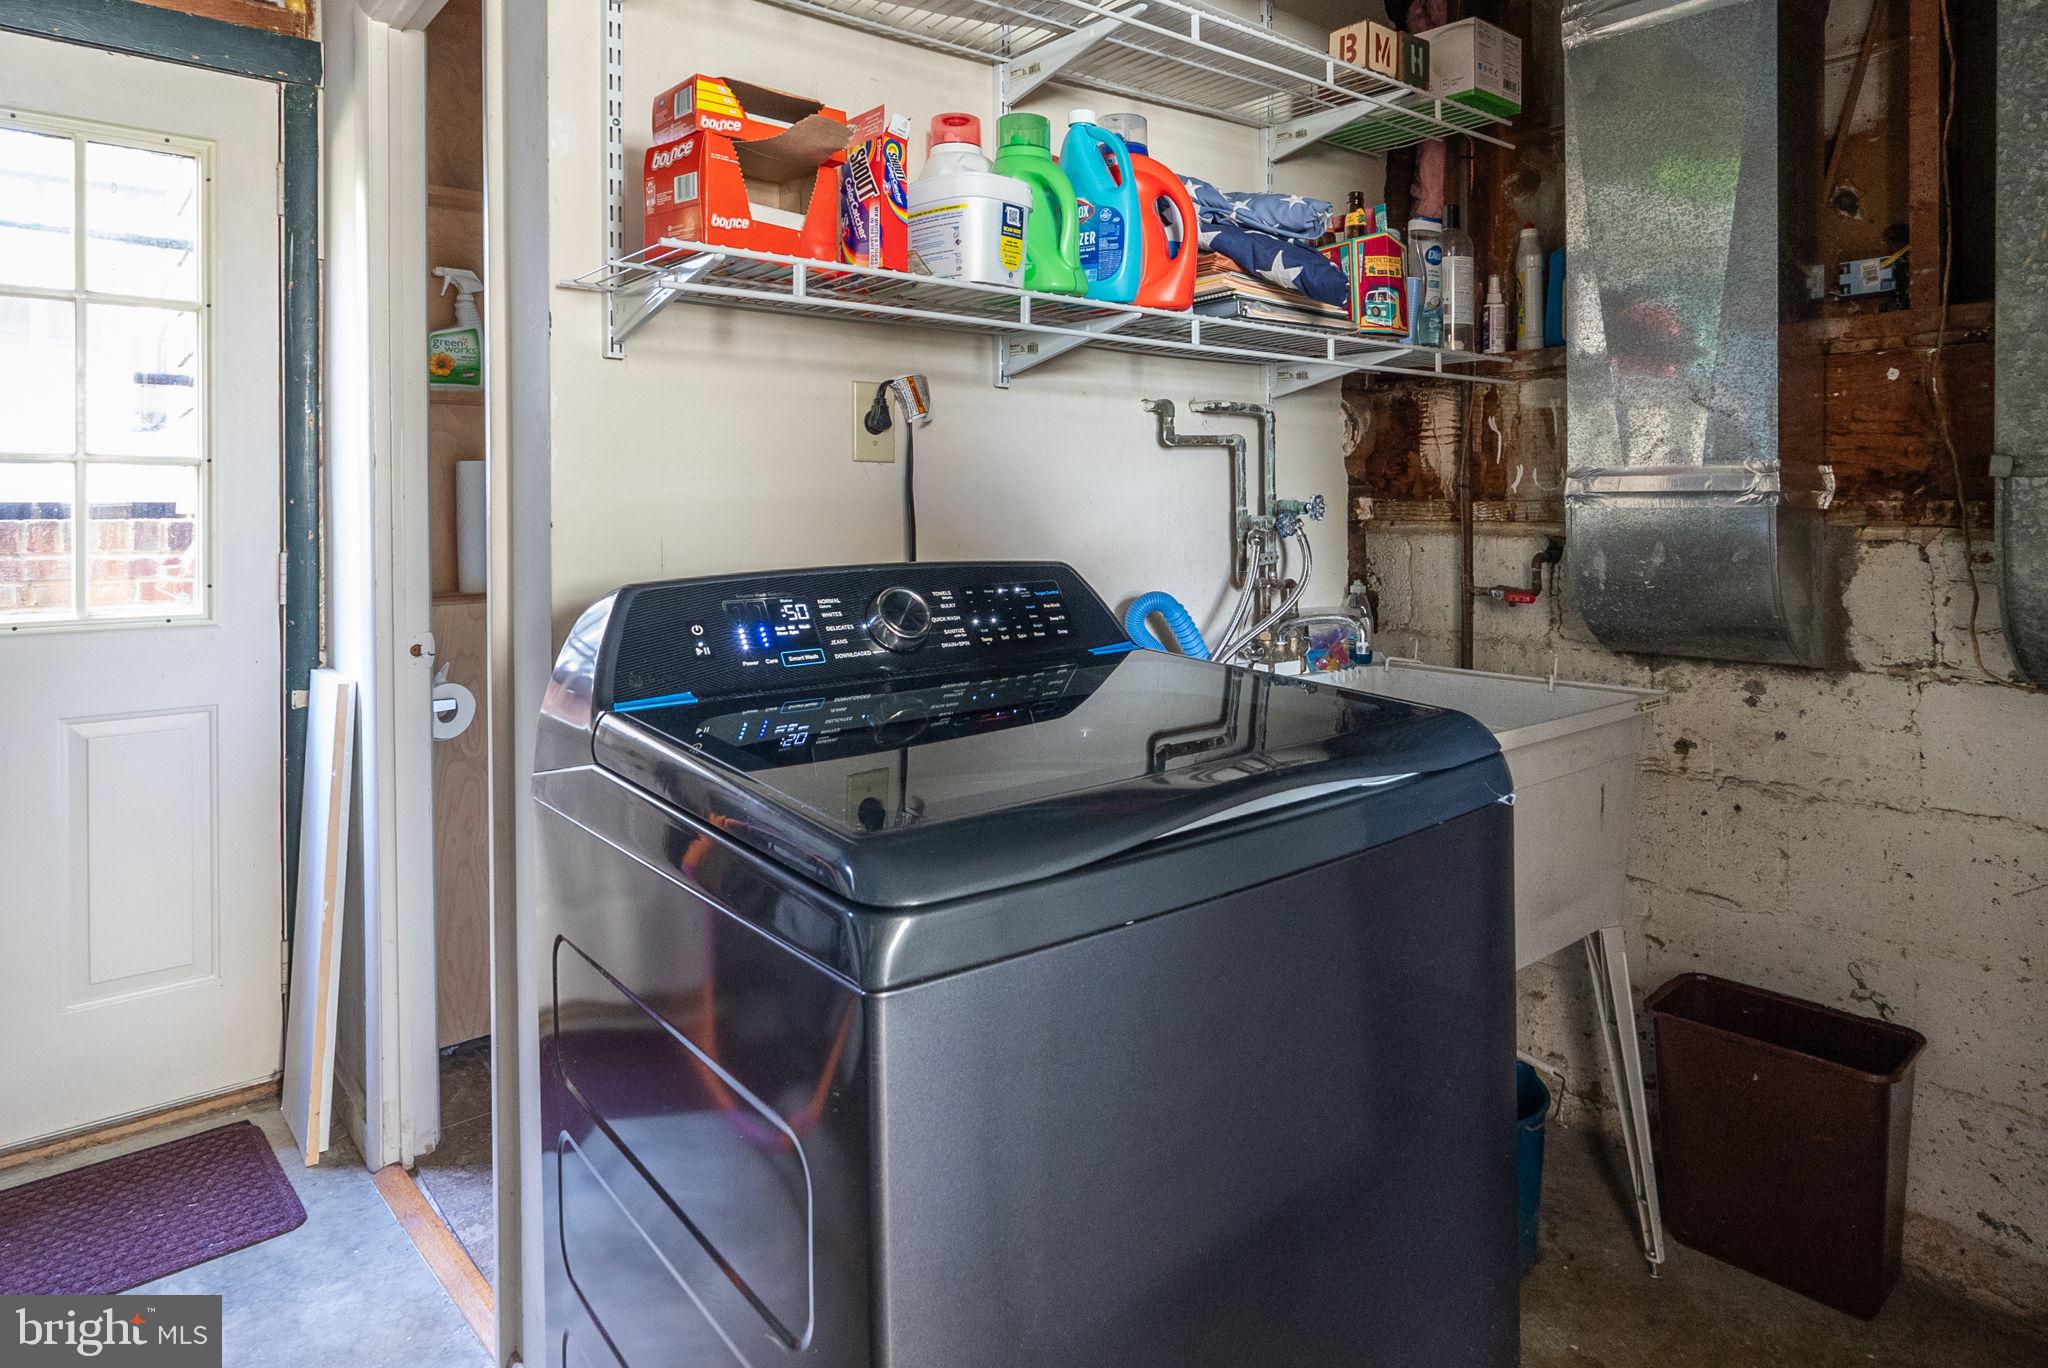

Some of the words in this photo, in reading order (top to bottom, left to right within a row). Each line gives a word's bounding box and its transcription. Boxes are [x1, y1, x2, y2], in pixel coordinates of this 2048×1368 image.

[1339, 33, 1357, 64] B
[1375, 32, 1391, 68] M
[1410, 44, 1424, 77] H
[701, 114, 742, 131] bounce
[652, 139, 694, 170] bounce
[889, 151, 905, 181] SHOUT
[849, 147, 879, 202] SHOUT
[711, 213, 750, 230] bounce
[432, 339, 464, 349] green
[444, 346, 477, 355] works
[825, 624, 854, 632] DELICATES
[834, 650, 872, 659] DOWNLOADED
